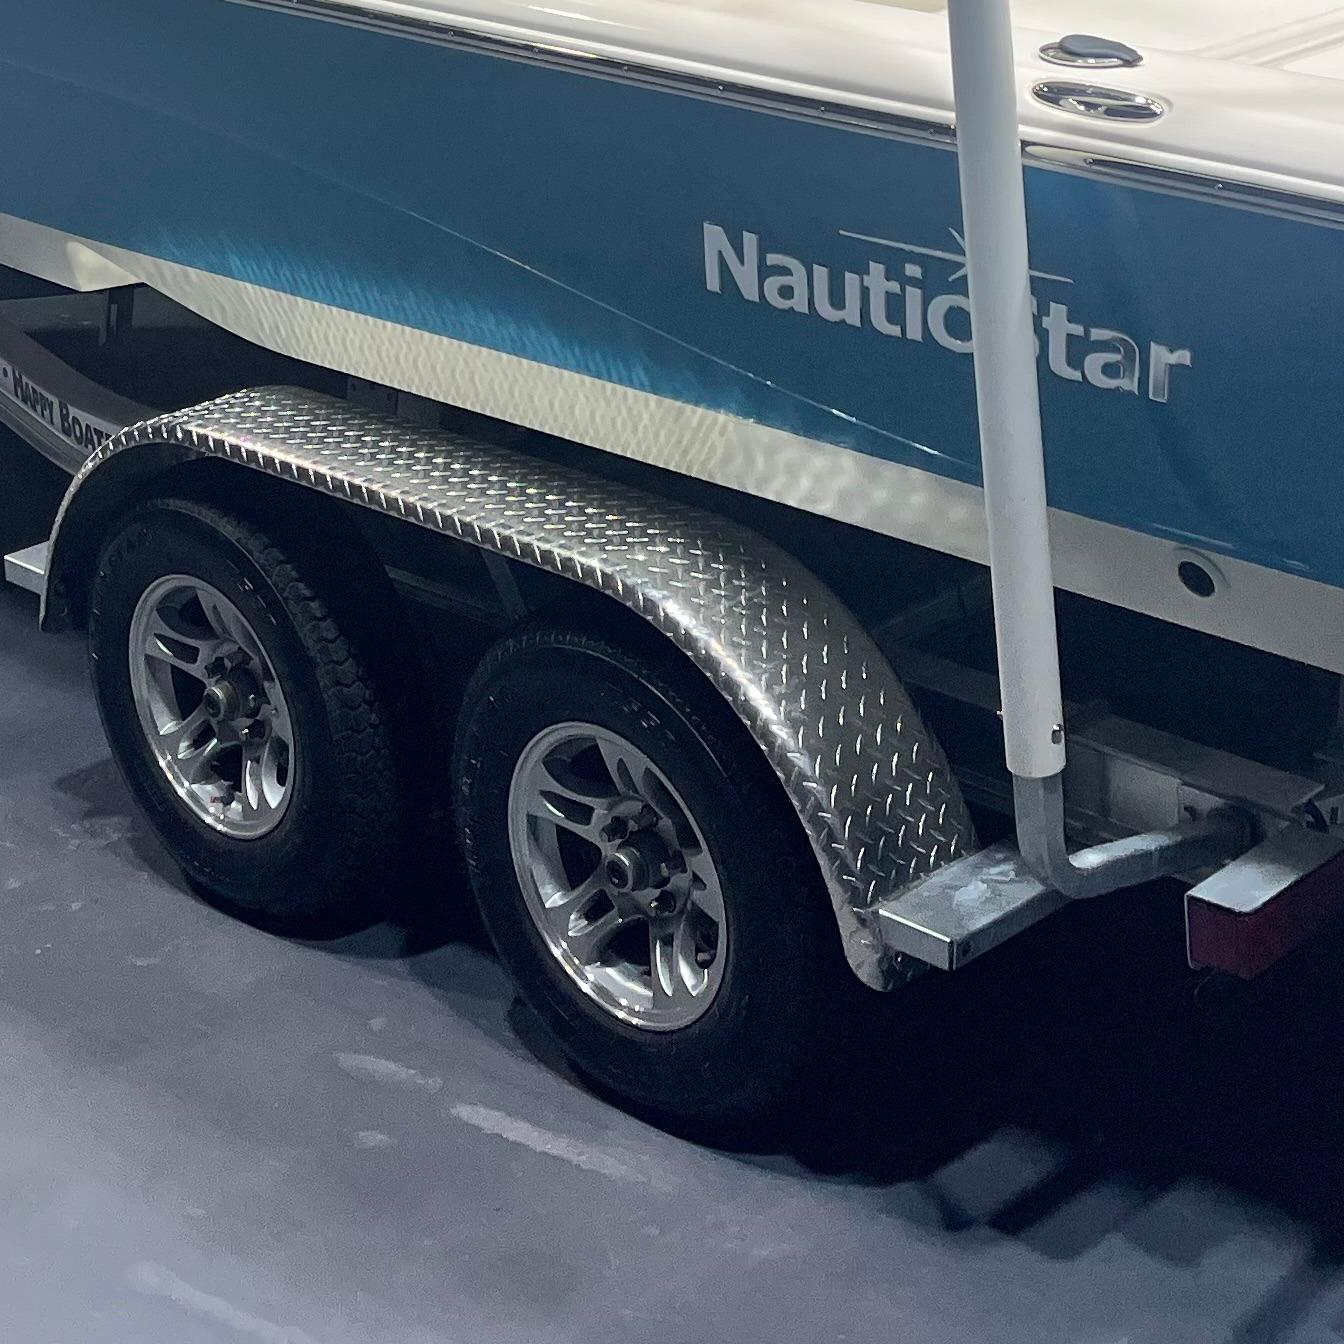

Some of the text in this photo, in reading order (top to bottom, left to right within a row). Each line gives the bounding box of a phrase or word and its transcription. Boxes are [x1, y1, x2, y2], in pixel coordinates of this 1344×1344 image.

[702, 220, 1193, 404] Nautictar
[11, 366, 114, 453] HAPPY BOAT
